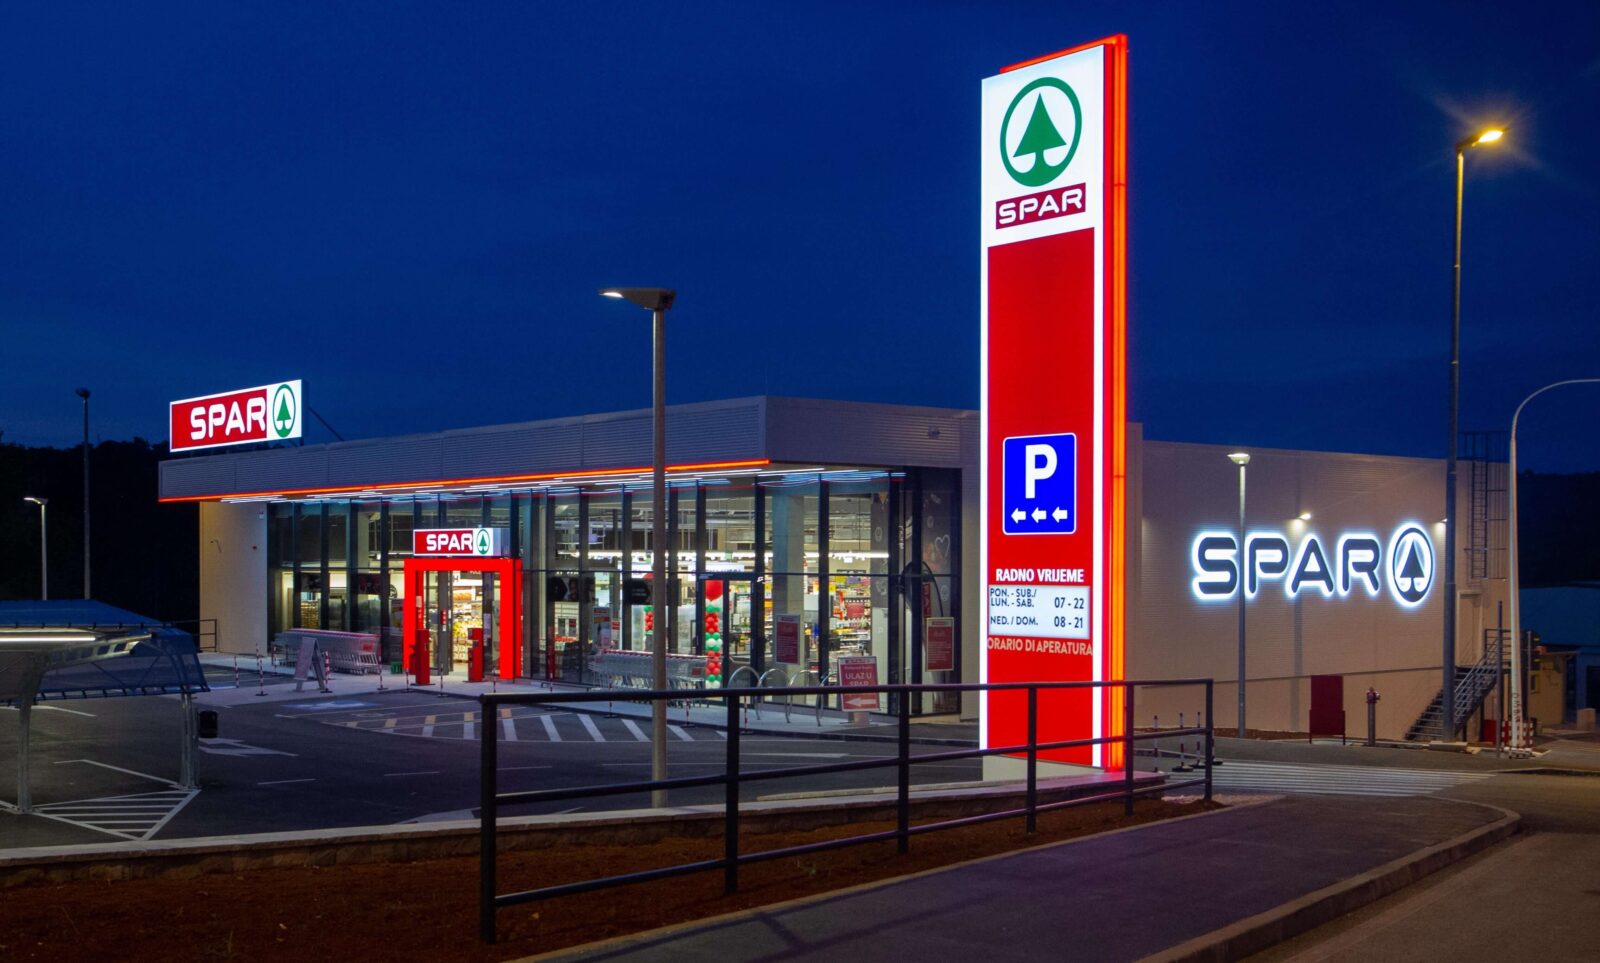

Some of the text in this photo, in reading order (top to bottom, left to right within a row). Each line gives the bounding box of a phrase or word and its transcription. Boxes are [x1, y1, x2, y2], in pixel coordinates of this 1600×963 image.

[999, 188, 1083, 225] SPAR
[190, 396, 266, 441] SPAR
[1025, 443, 1058, 499] P
[426, 532, 473, 552] SPAR
[1196, 534, 1381, 596] SPAR
[996, 568, 1084, 582] RADNO VRIJEME
[990, 588, 1010, 598] PON.
[991, 598, 1010, 607] LUN.
[1016, 598, 1035, 608] SAB.
[1054, 597, 1066, 609] 07
[1073, 597, 1085, 609] 22
[990, 616, 1010, 626] NED.
[1016, 616, 1039, 626] DOM.
[1054, 616, 1066, 628] 08
[1074, 616, 1084, 629] 21
[987, 637, 1023, 652] ORARIO
[1036, 641, 1093, 656] APERATURA
